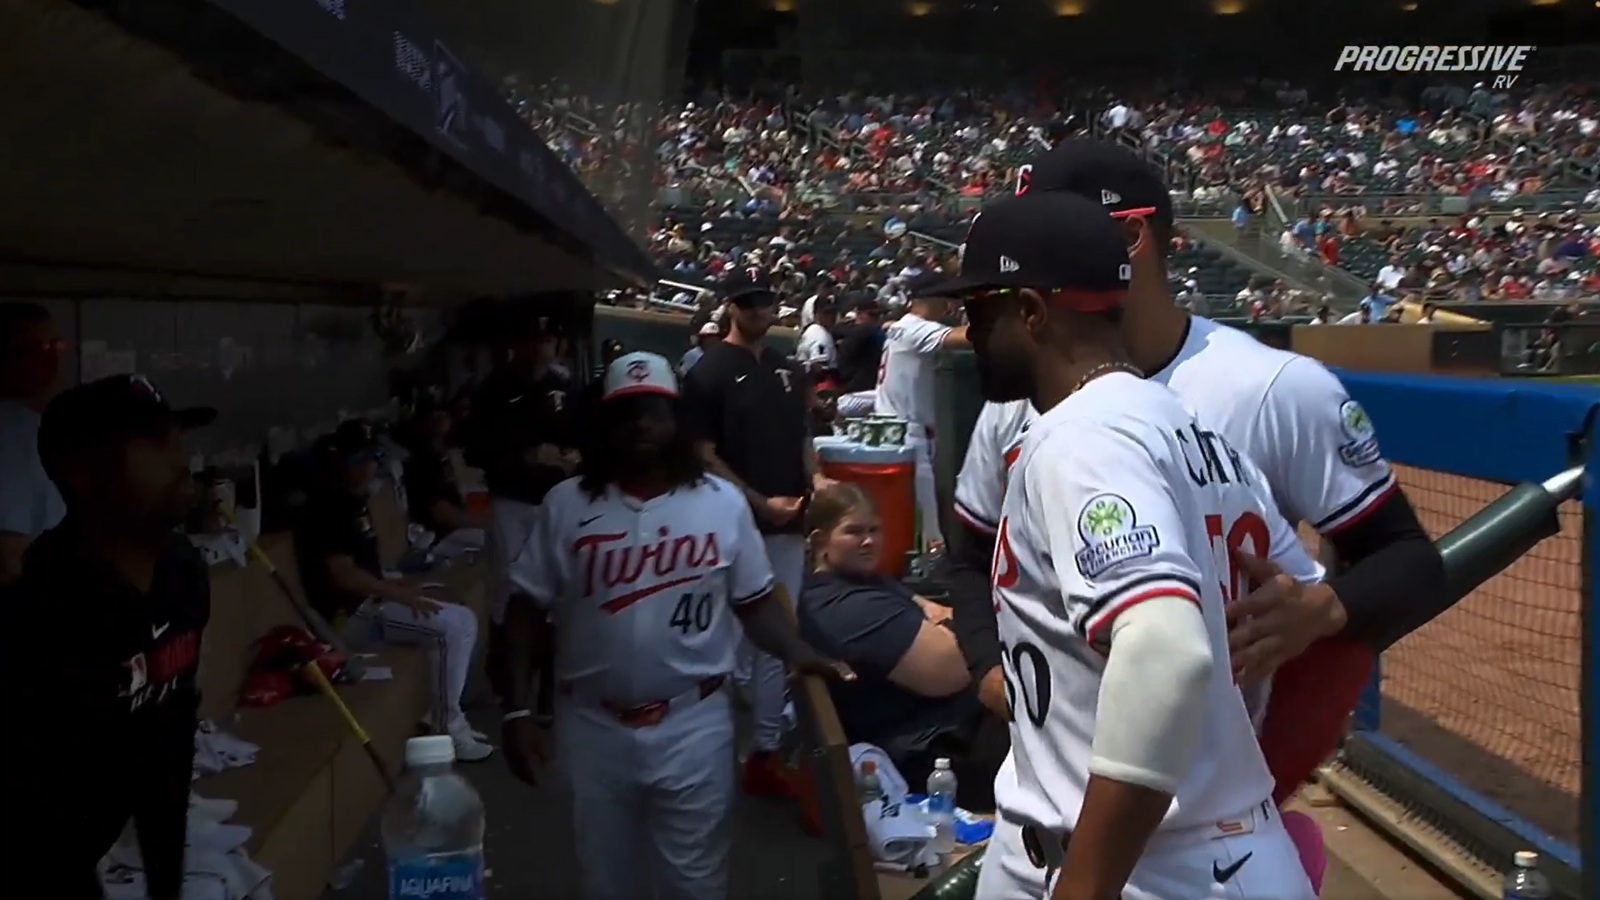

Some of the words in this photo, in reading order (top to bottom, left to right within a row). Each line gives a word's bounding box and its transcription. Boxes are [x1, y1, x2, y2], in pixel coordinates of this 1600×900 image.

[773, 368, 793, 393] T
[574, 525, 719, 598] Twins
[670, 593, 712, 634] 40
[400, 874, 474, 899] AQUAFINA
